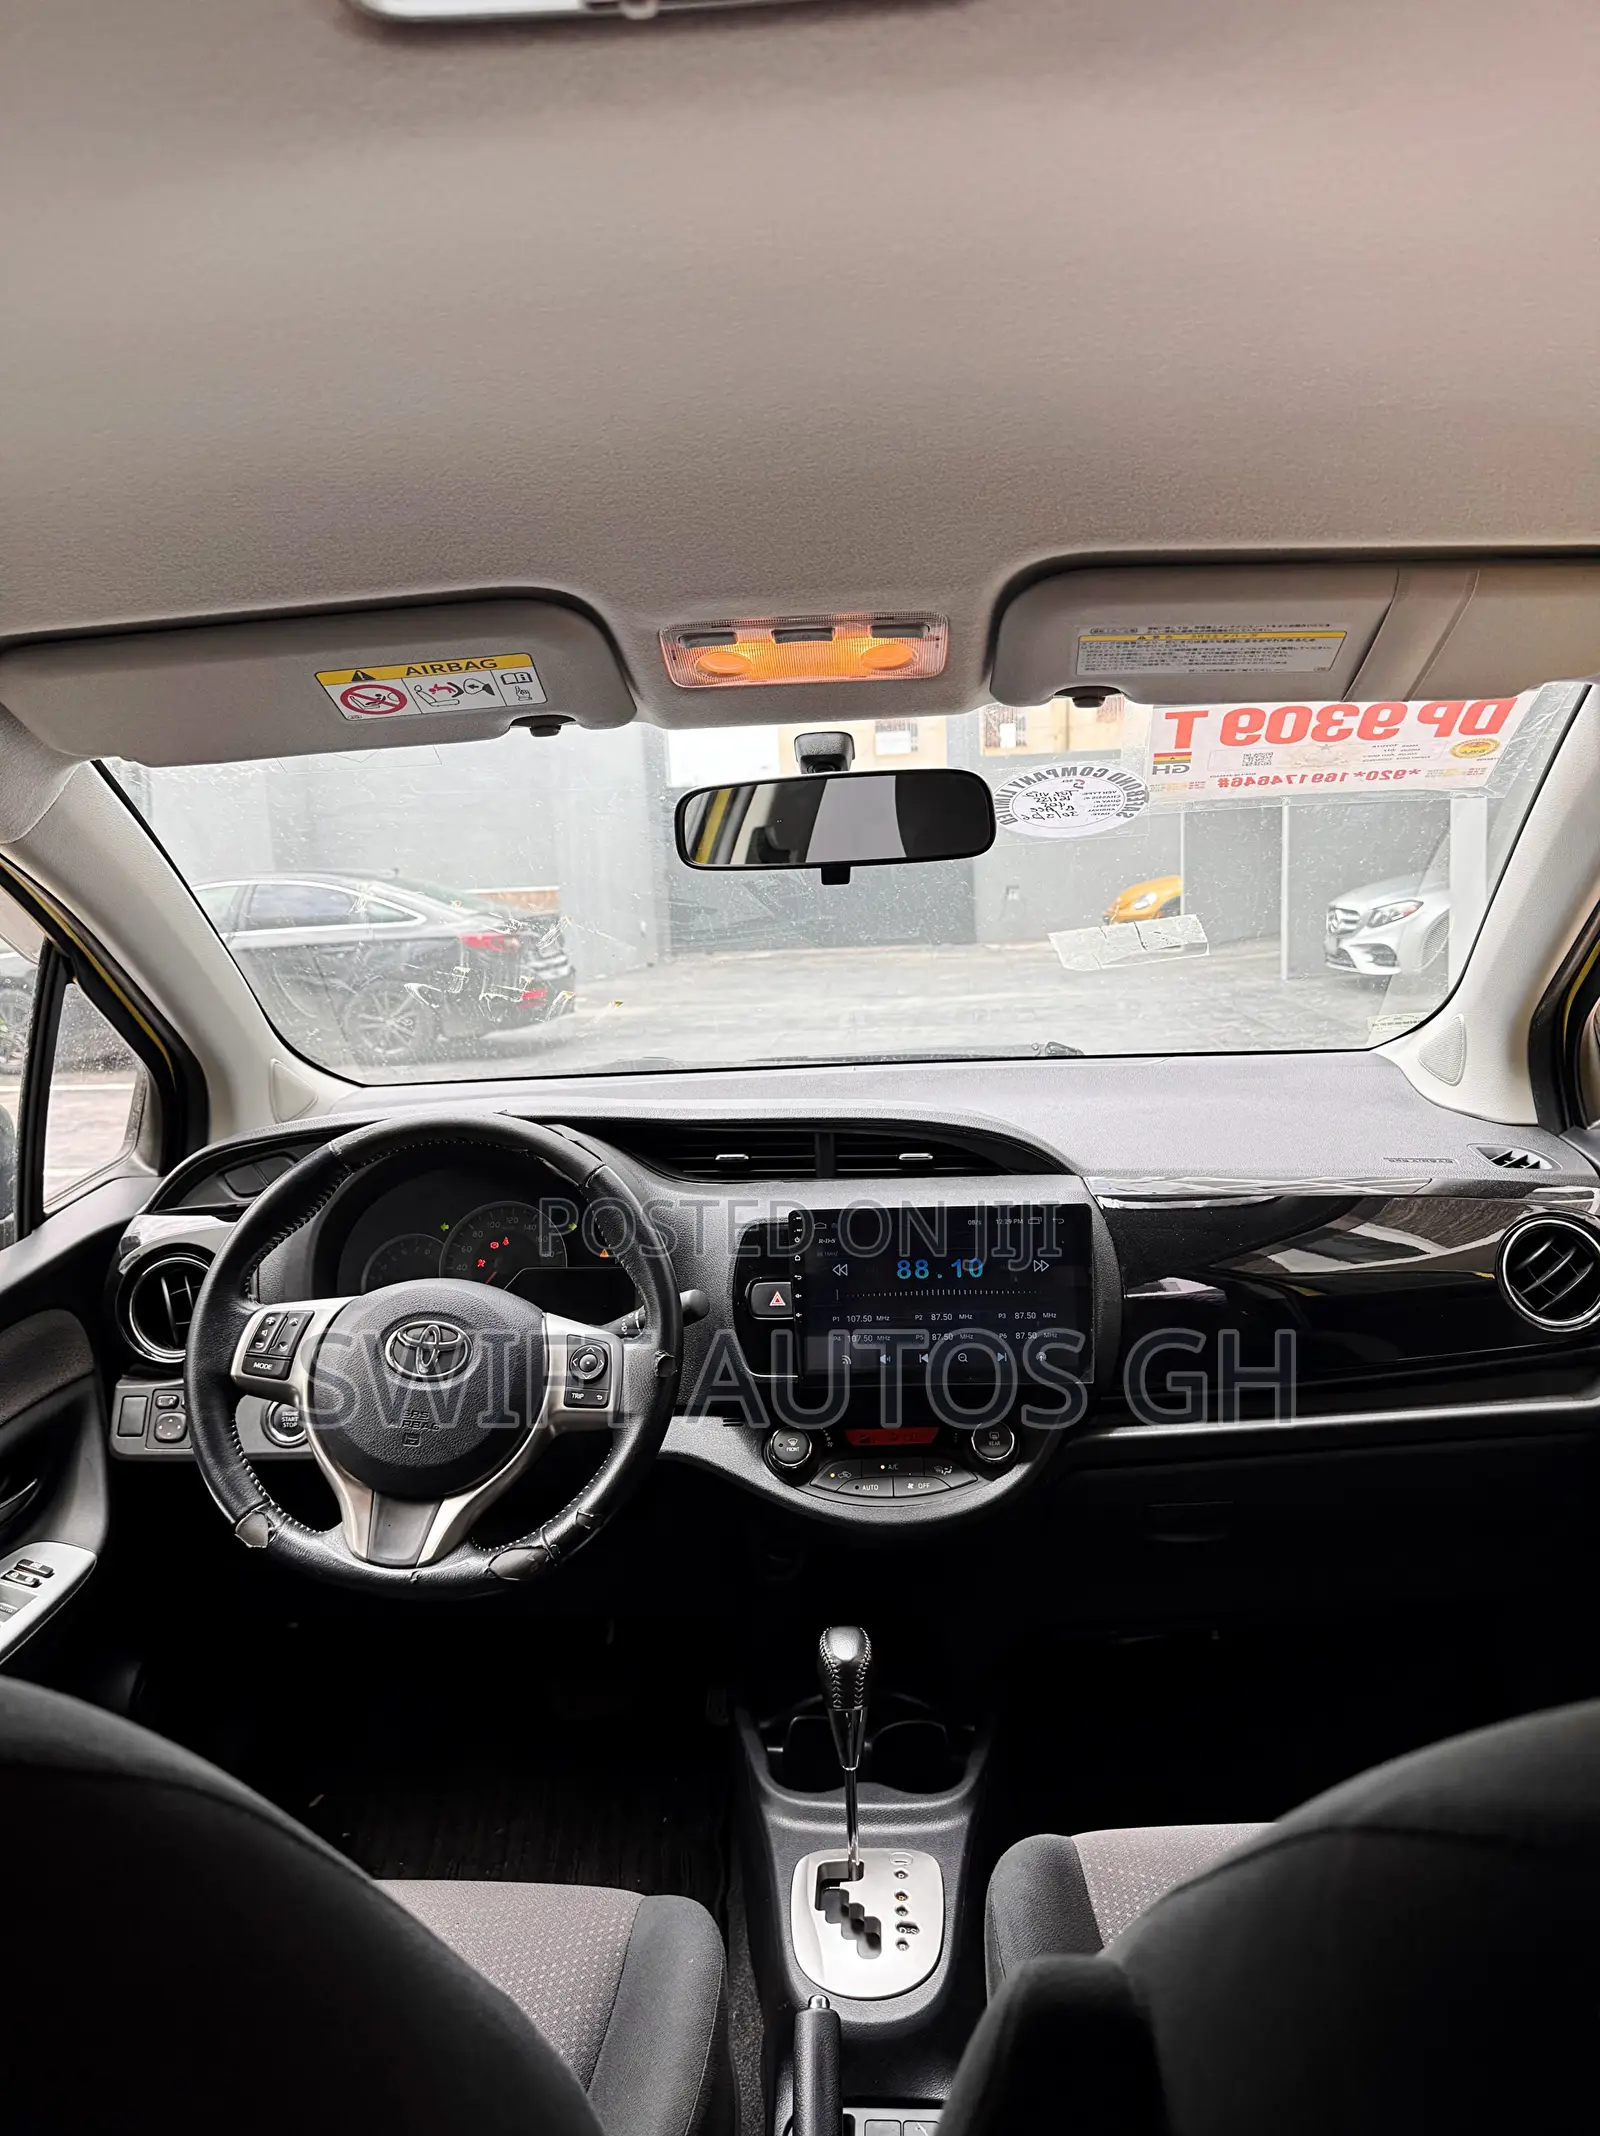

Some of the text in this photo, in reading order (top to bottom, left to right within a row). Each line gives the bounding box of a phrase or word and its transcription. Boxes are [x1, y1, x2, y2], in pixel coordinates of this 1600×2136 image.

[405, 658, 498, 677] AIRBAG
[461, 1245, 472, 1253] 60
[897, 1258, 984, 1280] 88.10
[847, 1314, 873, 1323] 107.50
[931, 1313, 953, 1321] 87.50
[1014, 1312, 1036, 1320] 87.50
[847, 1334, 873, 1342] 107.50
[932, 1333, 954, 1341] 87.50
[1015, 1331, 1037, 1340] 87.50
[253, 1361, 273, 1371] MODE
[572, 1392, 584, 1400] TRIP
